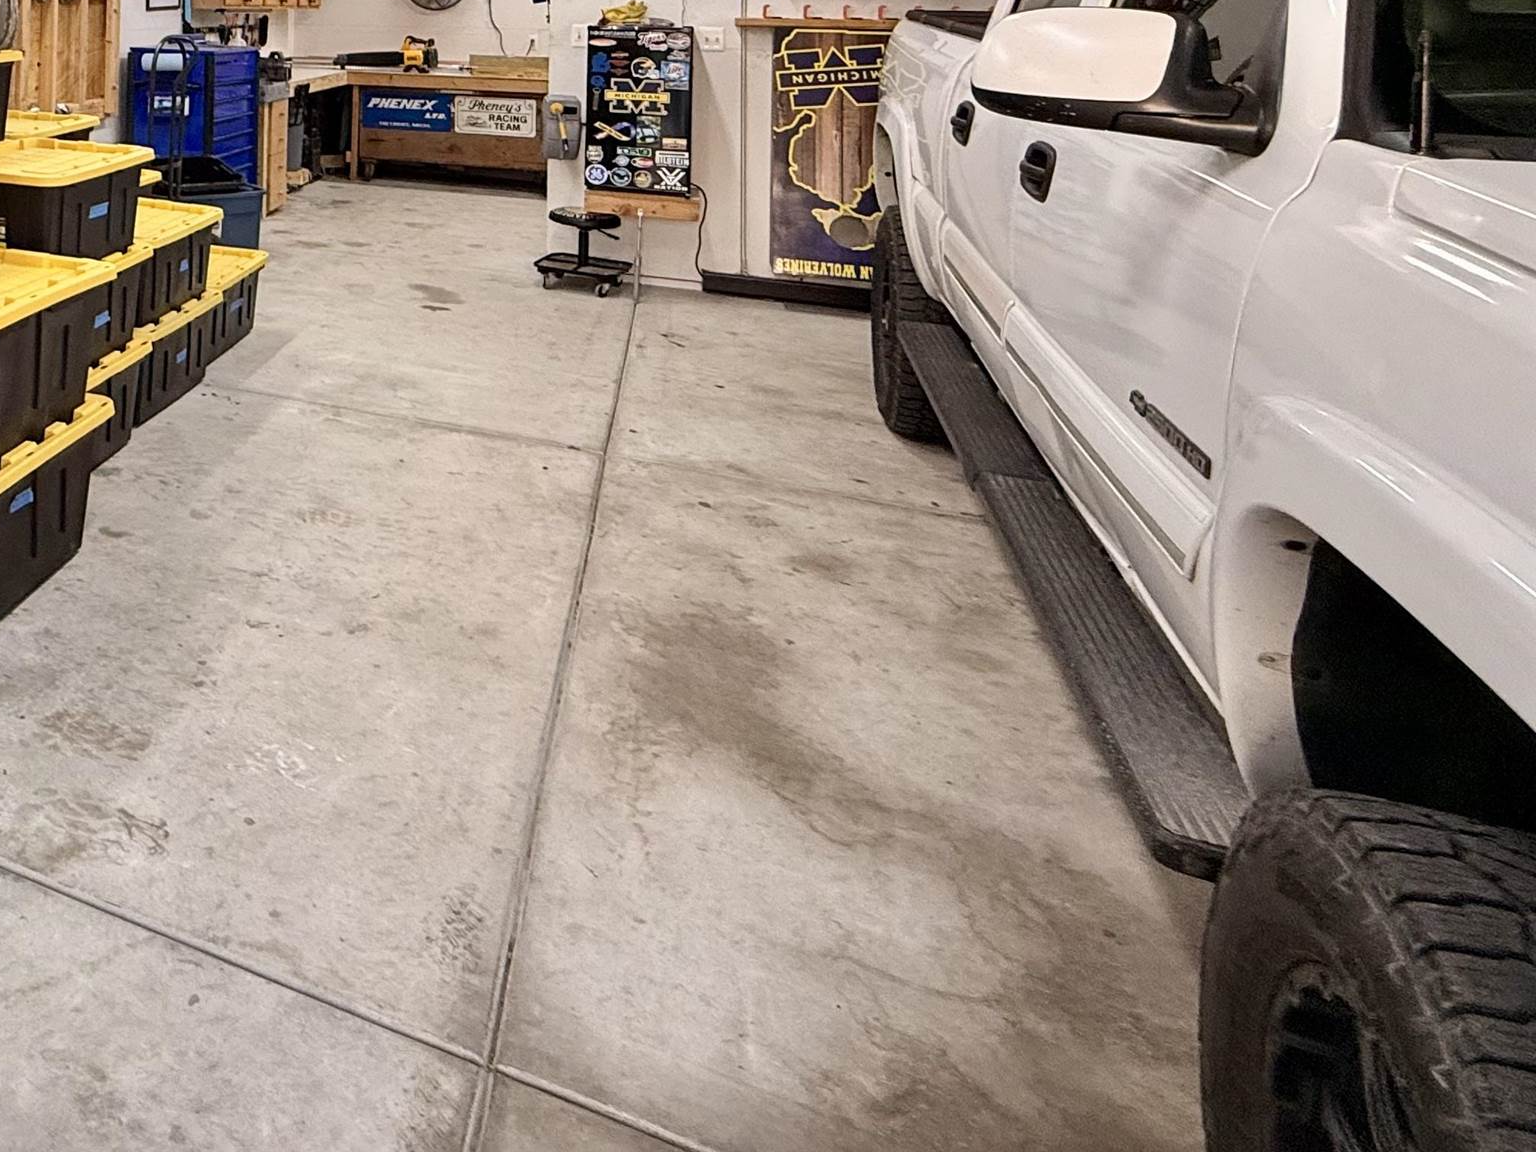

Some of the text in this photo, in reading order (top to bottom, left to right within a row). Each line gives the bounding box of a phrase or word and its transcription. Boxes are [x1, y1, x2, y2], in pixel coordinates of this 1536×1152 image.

[792, 70, 881, 84] MICHIGAN
[367, 97, 439, 111] PHENEX
[467, 99, 522, 113] Pheney's
[488, 114, 528, 123] RACING
[494, 123, 521, 131] TEAM
[773, 257, 857, 279] WOLVERINES
